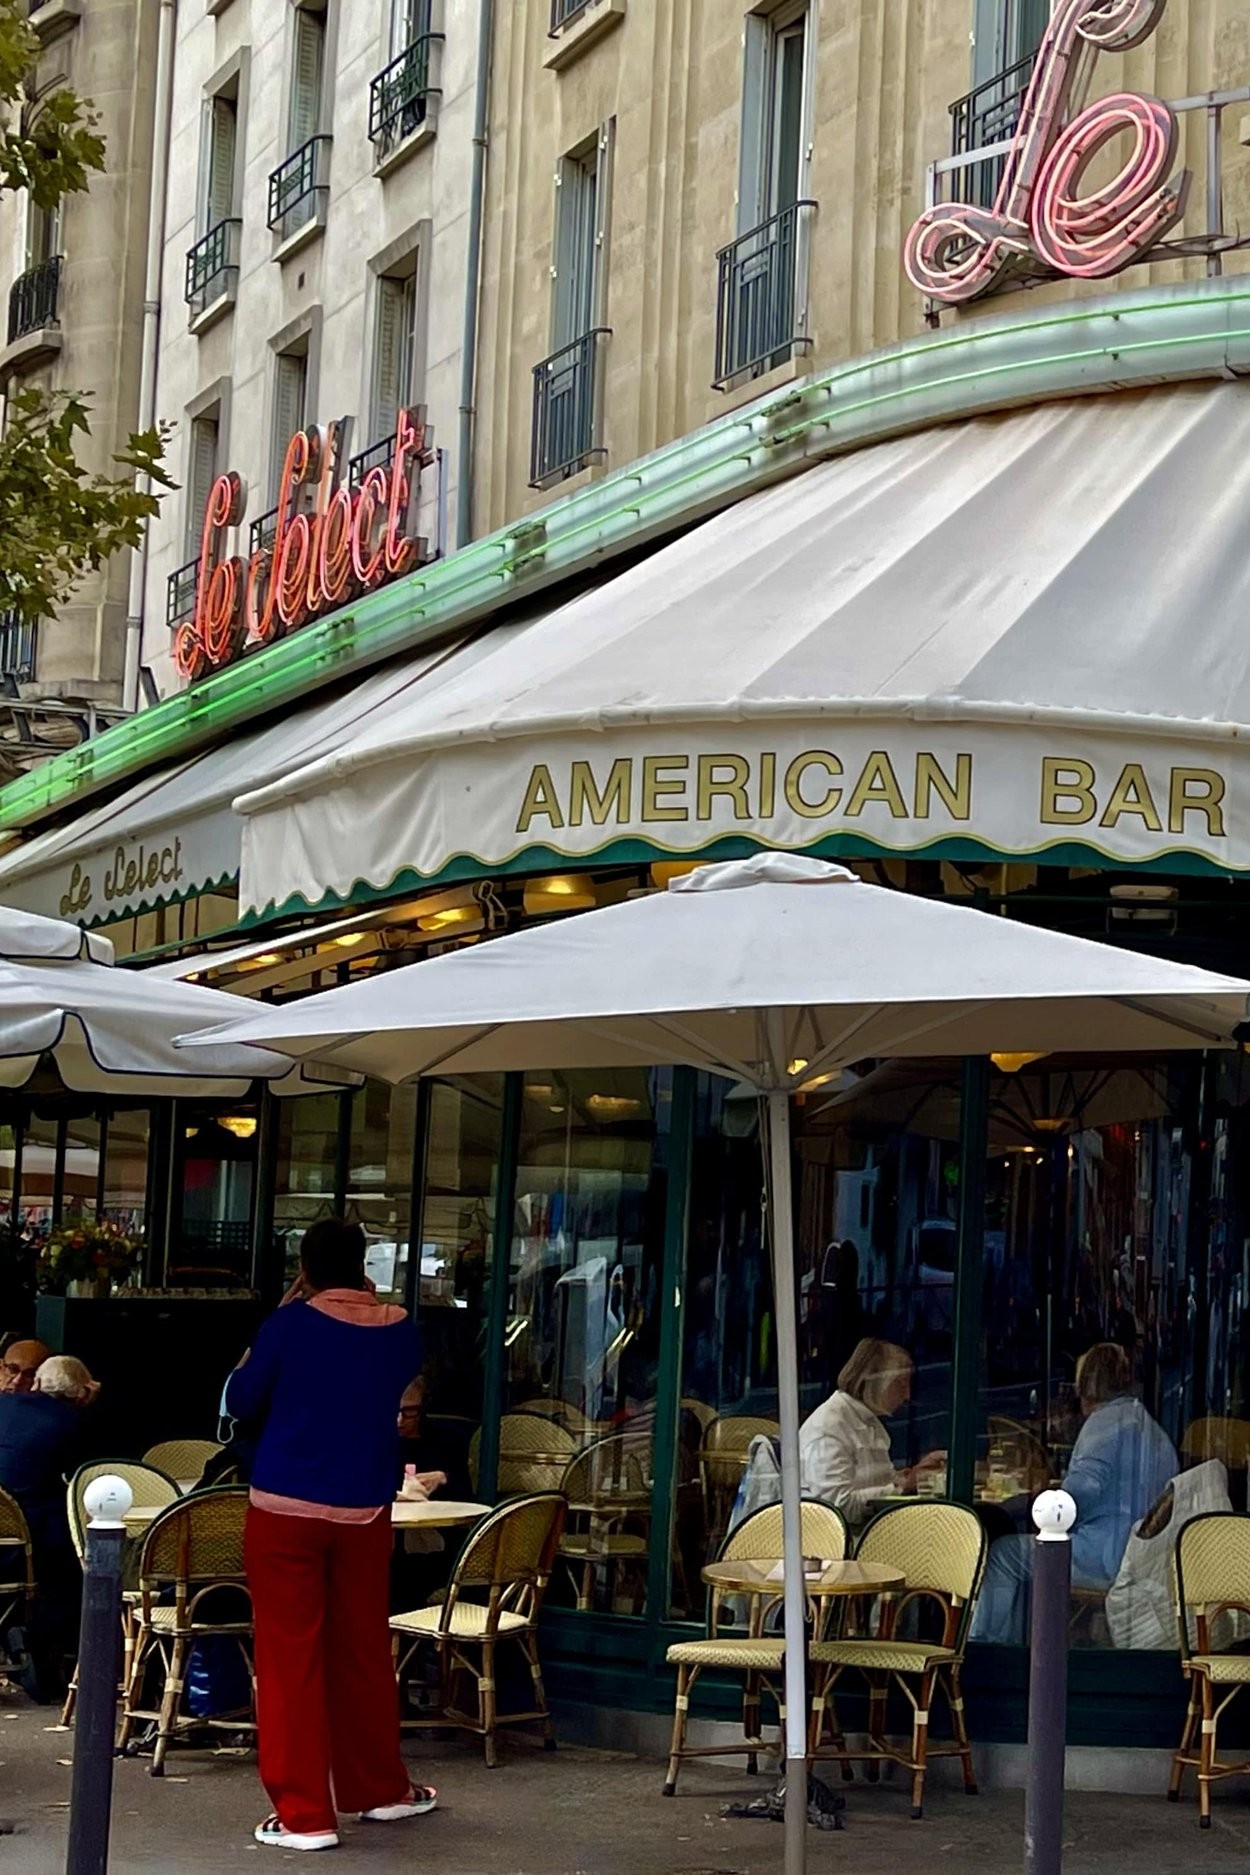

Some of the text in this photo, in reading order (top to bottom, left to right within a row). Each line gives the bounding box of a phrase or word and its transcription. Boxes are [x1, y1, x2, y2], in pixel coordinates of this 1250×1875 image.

[905, 0, 1191, 301] Le
[174, 404, 430, 680] Le Select
[59, 836, 183, 916] Le Select
[515, 749, 1228, 837] AMERICAN BAR
